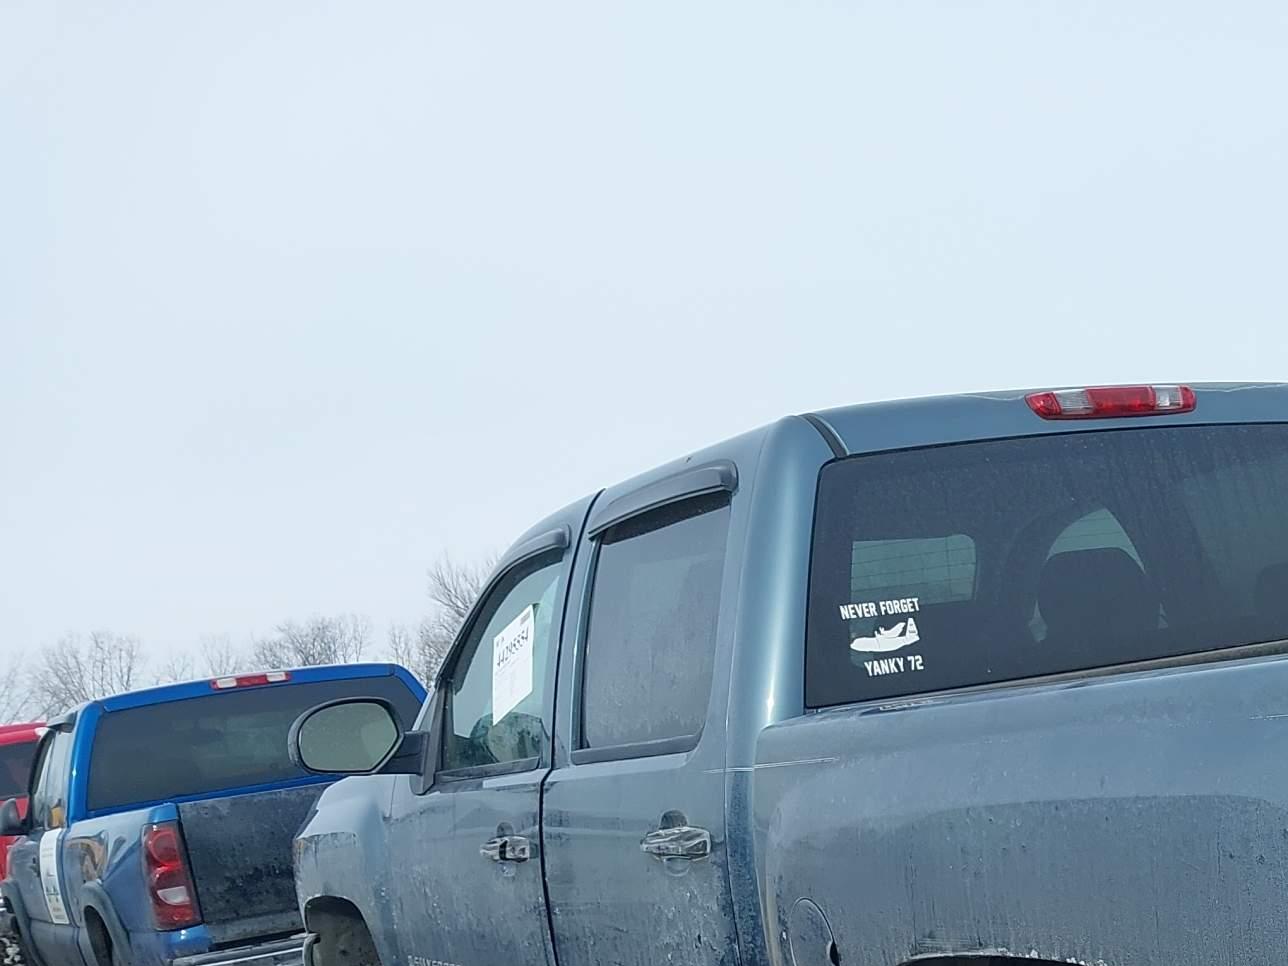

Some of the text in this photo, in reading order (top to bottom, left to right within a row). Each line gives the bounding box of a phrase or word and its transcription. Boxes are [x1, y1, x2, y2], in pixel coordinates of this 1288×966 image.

[839, 597, 920, 620] NEVER FORGET
[864, 655, 924, 676] YANKY 72
